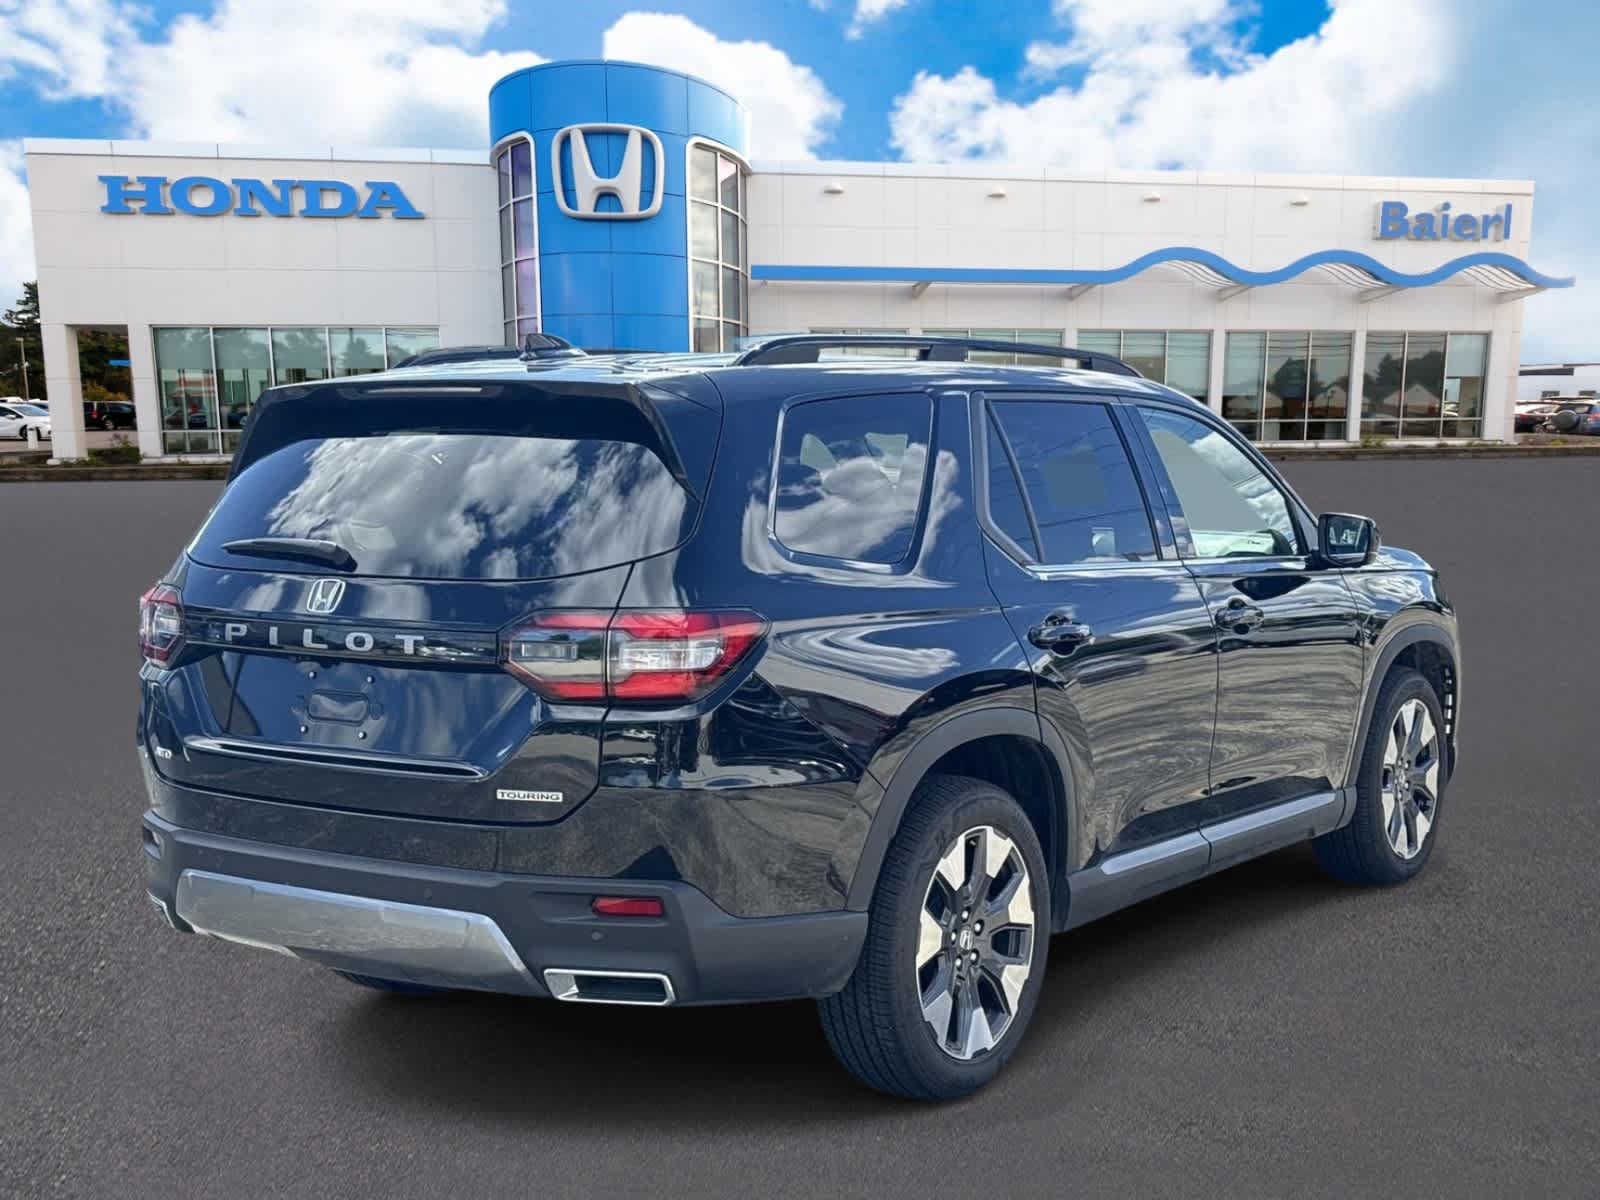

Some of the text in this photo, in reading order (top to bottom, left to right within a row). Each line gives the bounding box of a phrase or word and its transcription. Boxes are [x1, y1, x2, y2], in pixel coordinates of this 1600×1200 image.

[98, 175, 425, 219] HONDA
[1379, 200, 1513, 240] Baierl
[224, 622, 425, 655] PILOT
[497, 790, 562, 801] TOURING
